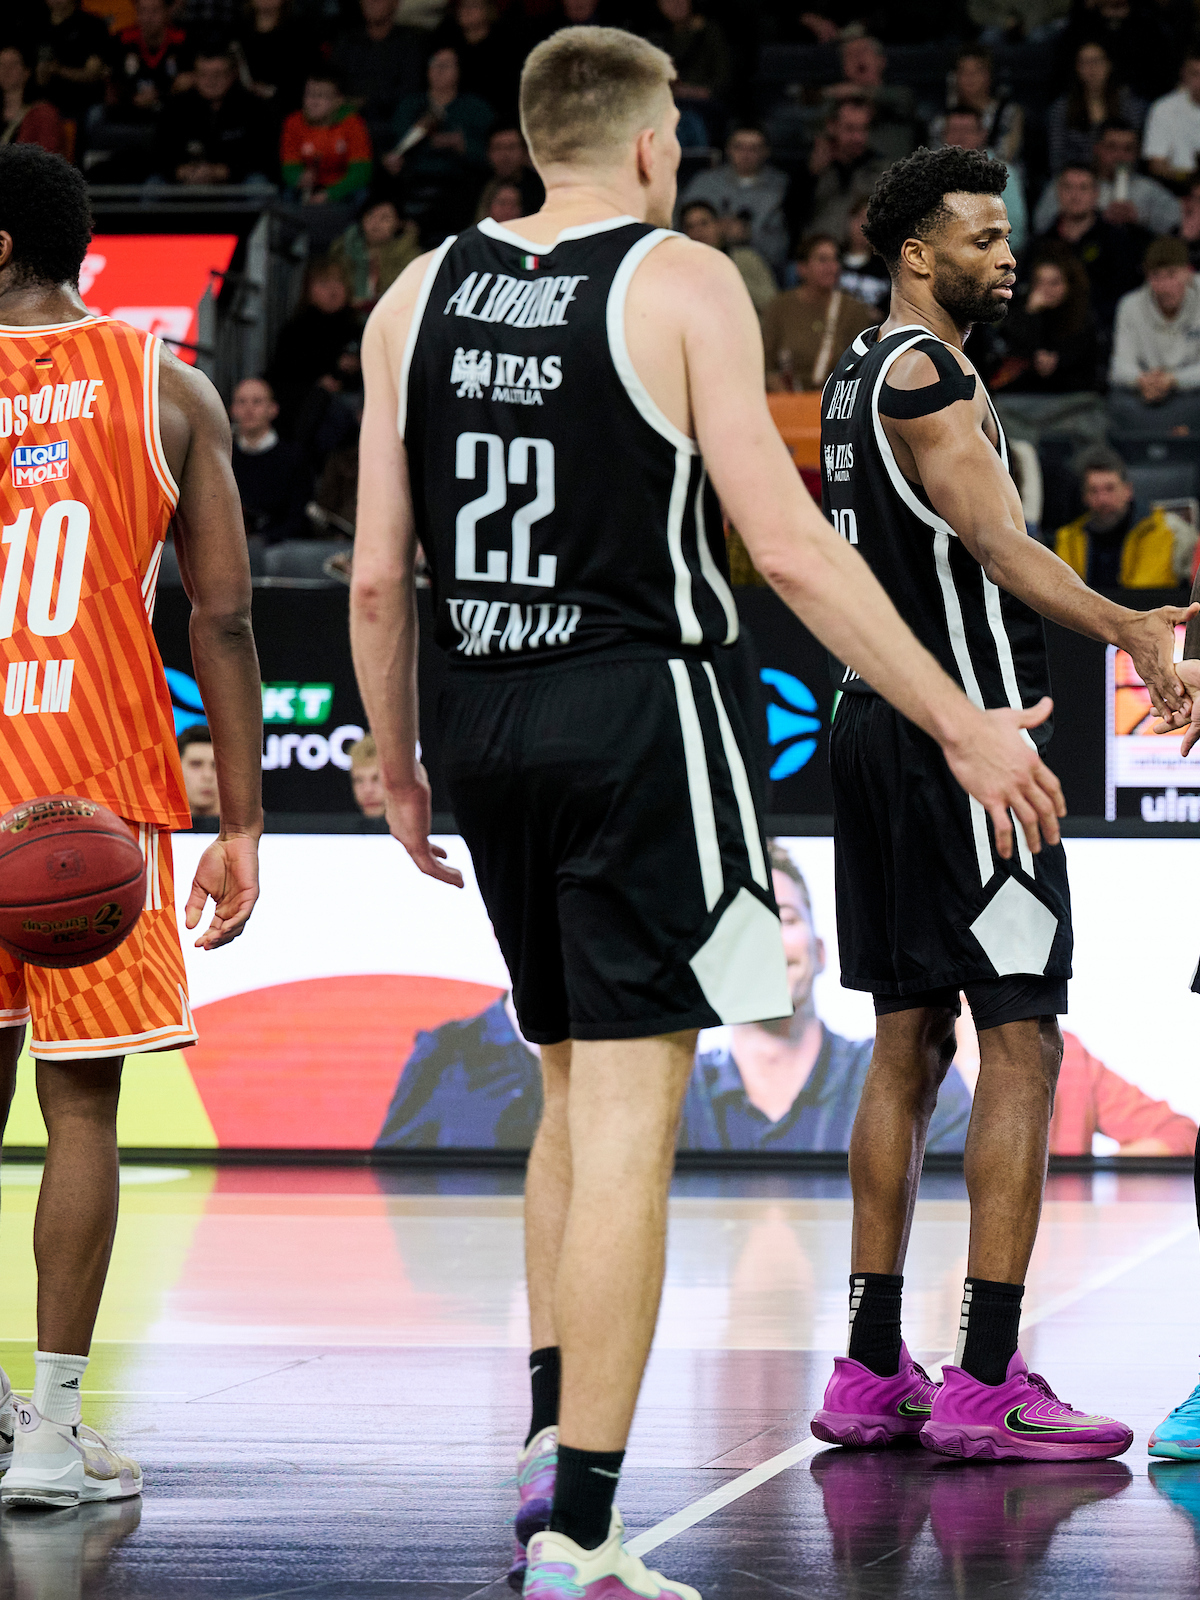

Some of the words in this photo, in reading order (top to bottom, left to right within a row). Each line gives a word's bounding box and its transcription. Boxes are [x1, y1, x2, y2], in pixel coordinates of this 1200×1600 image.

[493, 353, 563, 390] ITAS
[0, 379, 104, 438] OSORNE
[15, 441, 67, 467] LIQUI
[15, 461, 67, 485] MOLY
[455, 431, 557, 588] 22
[0, 499, 91, 640] 10
[3, 659, 75, 717] ULM
[262, 687, 332, 720] KT
